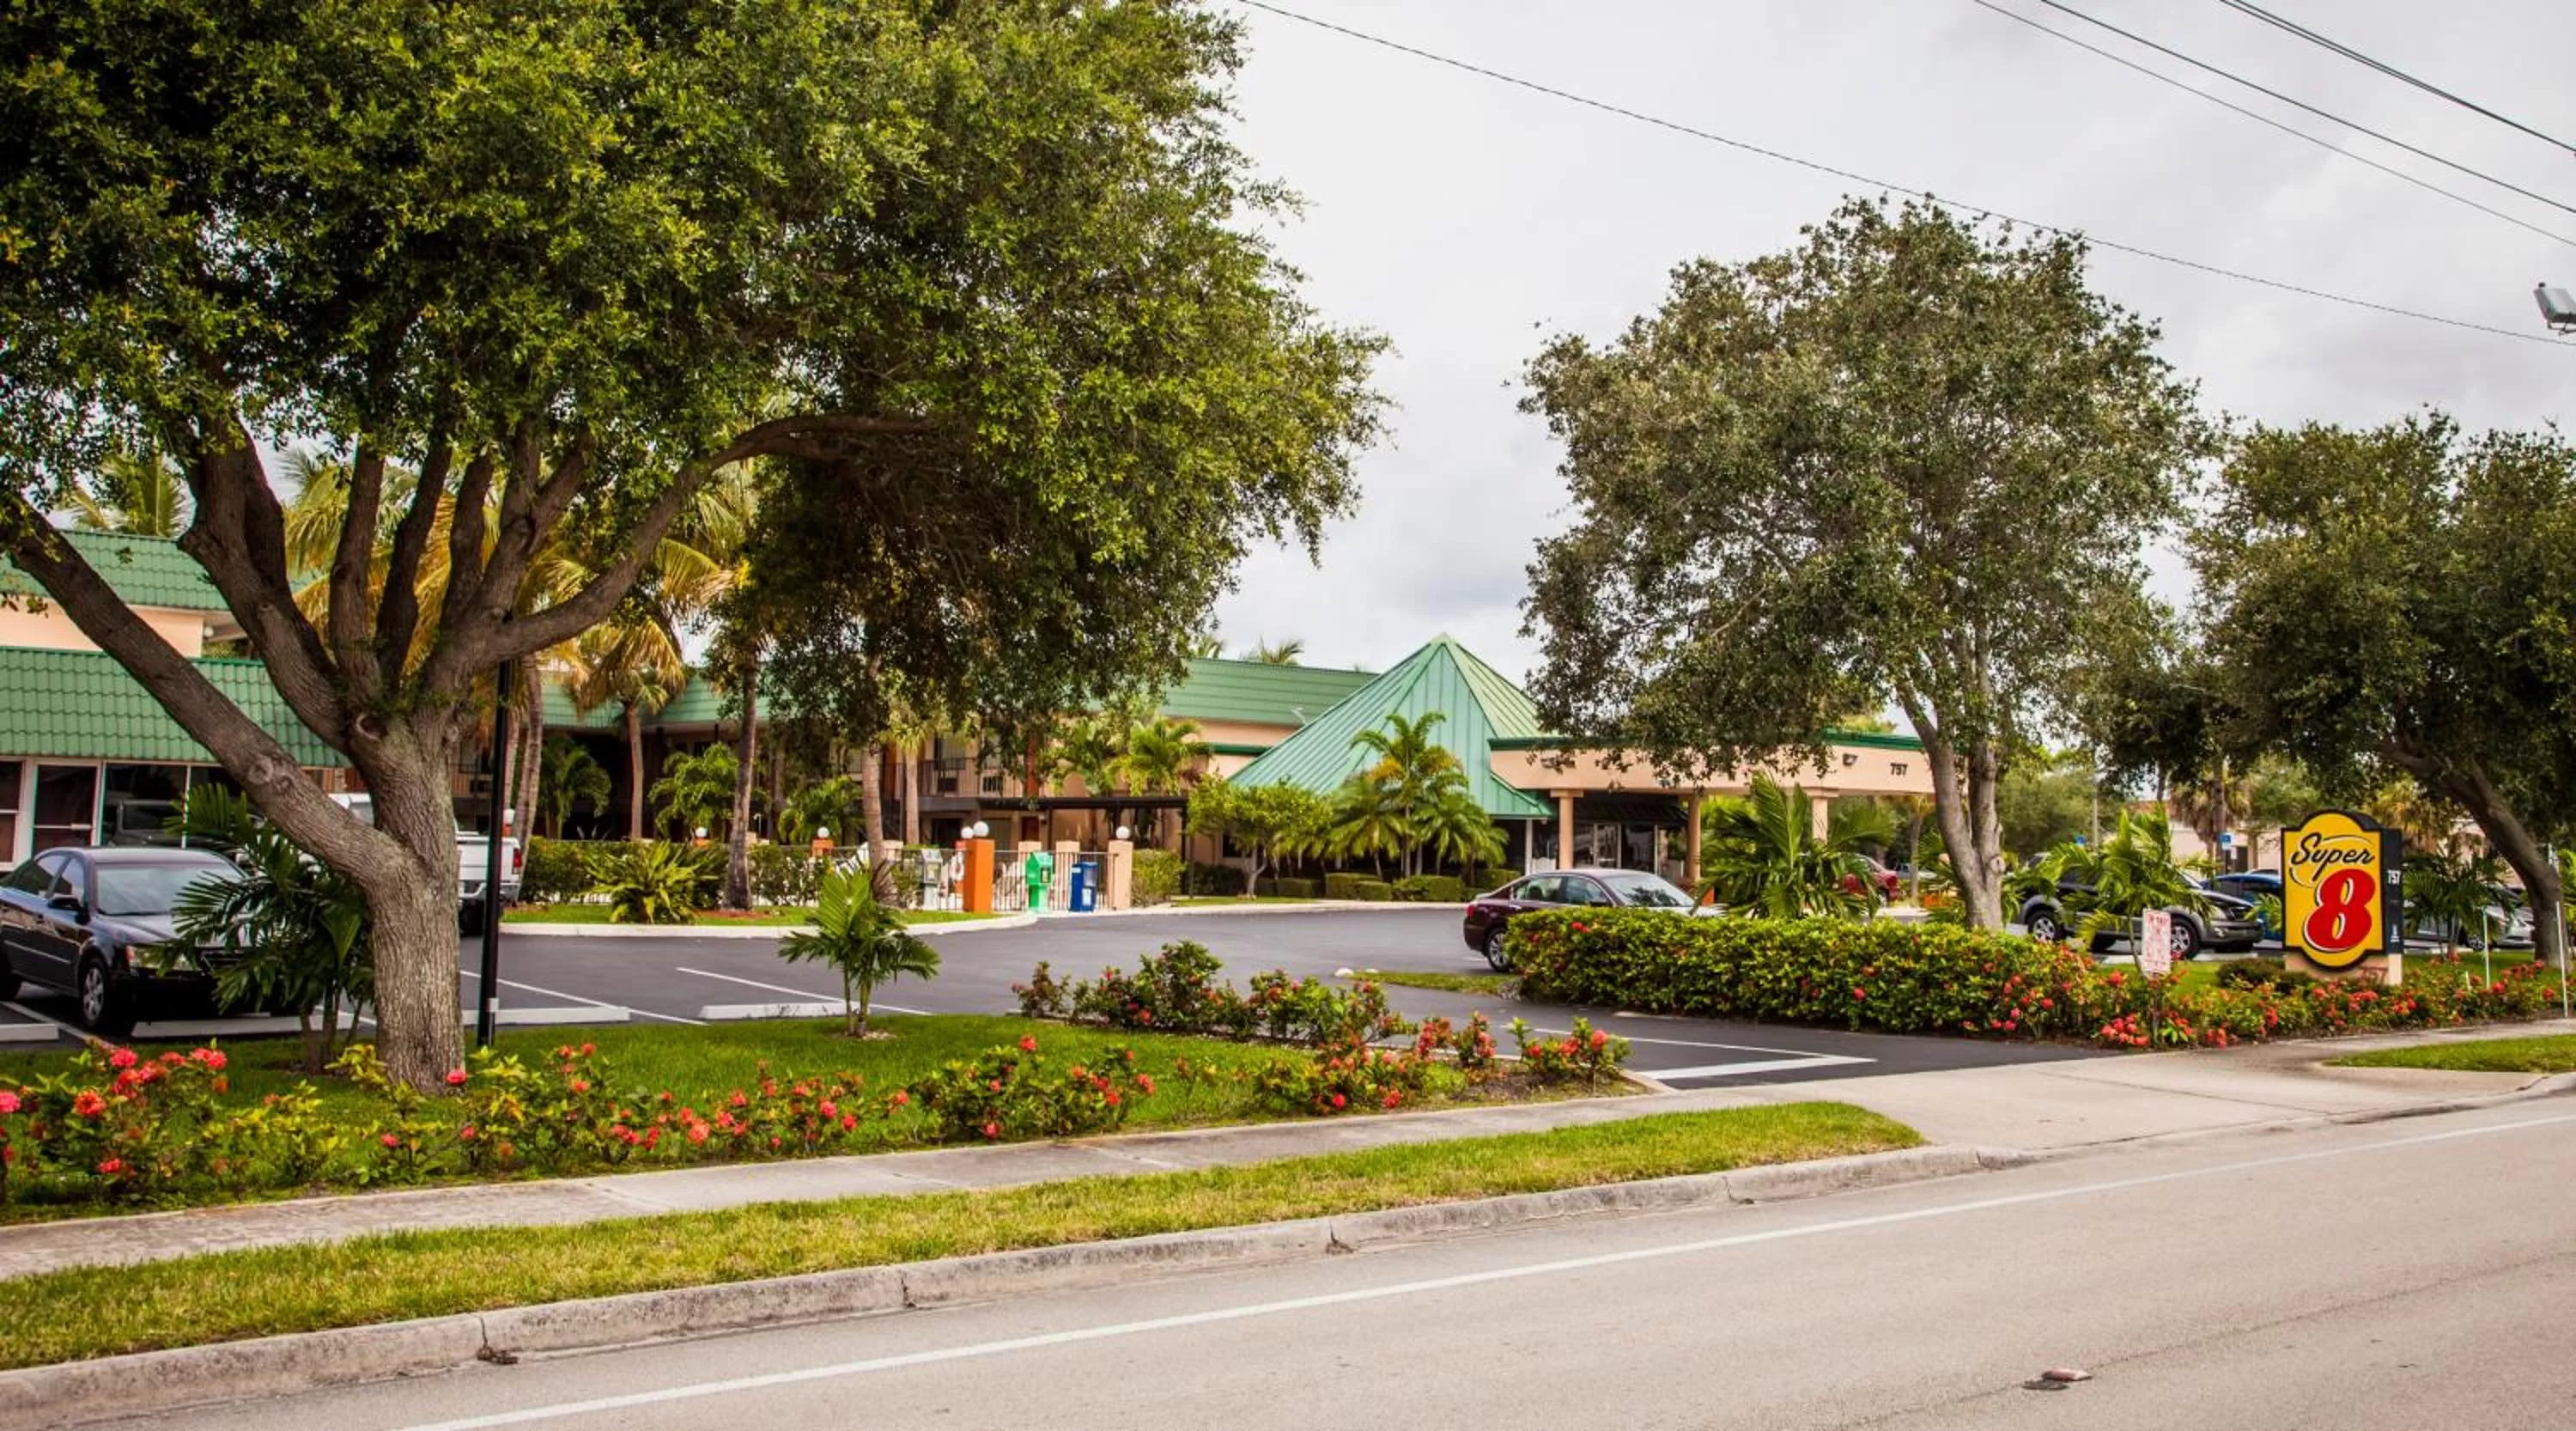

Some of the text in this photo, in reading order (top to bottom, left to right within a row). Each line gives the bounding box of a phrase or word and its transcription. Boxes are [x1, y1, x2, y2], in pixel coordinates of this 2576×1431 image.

[1890, 762, 1908, 776] 757
[2290, 832, 2375, 883] Super
[2387, 869, 2401, 885] 757
[2304, 868, 2376, 952] 8
